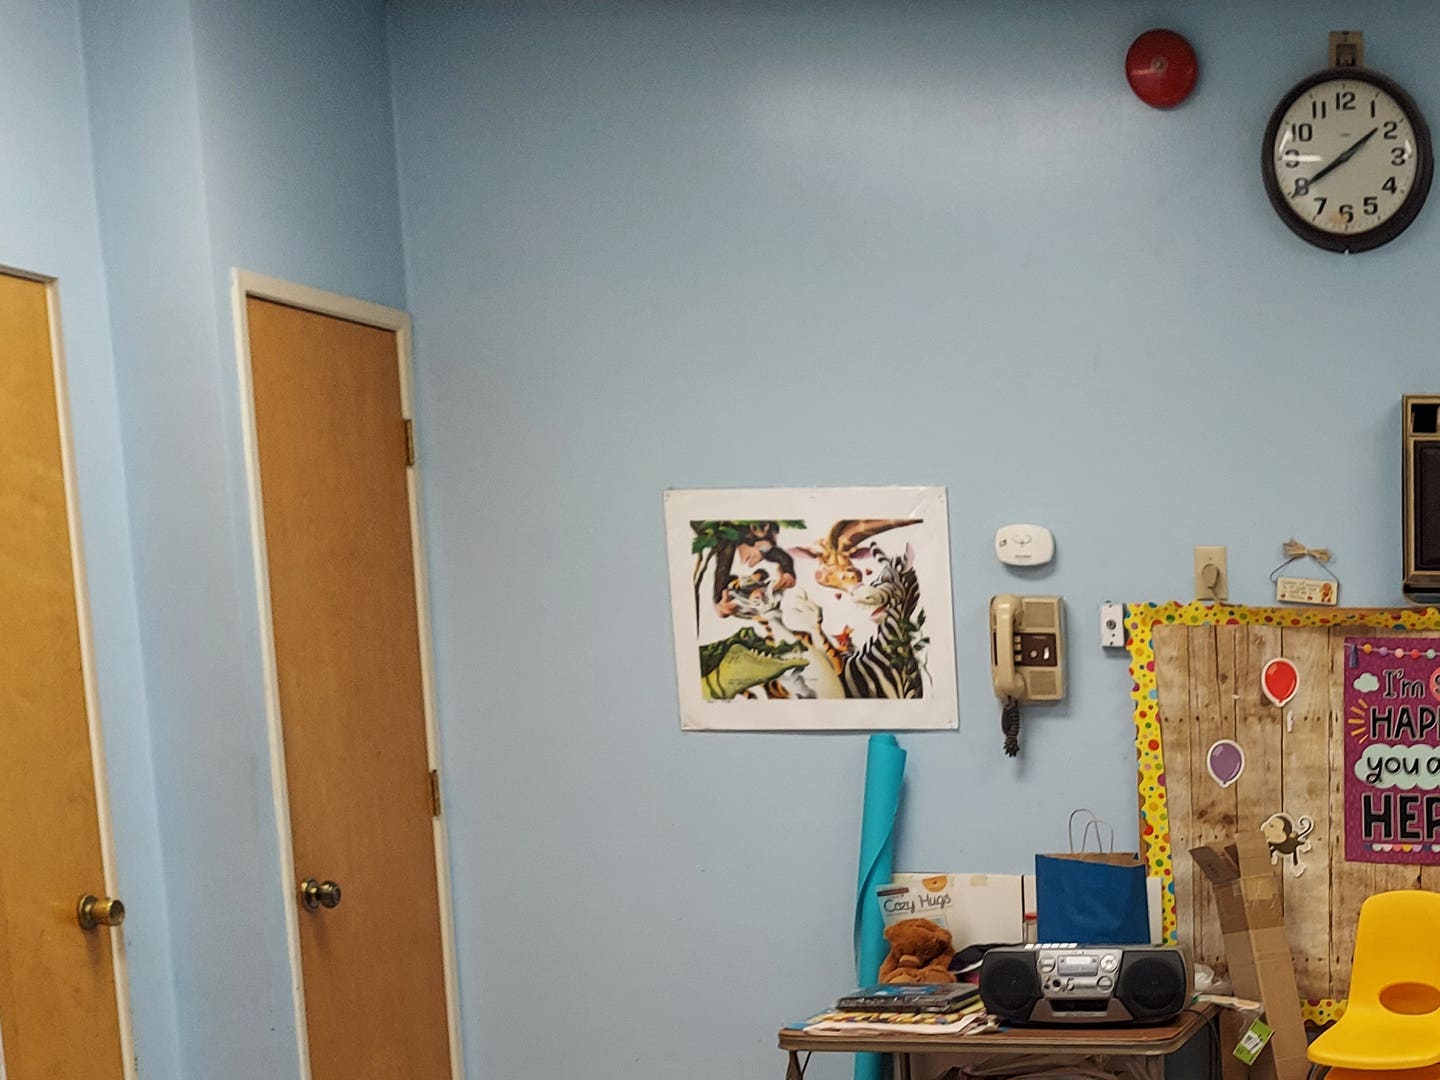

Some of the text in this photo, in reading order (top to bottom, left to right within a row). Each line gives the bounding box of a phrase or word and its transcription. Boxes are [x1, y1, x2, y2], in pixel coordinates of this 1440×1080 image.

[1312, 100, 1326, 119] 11
[1335, 91, 1356, 111] 12
[1291, 123, 1313, 142] 10
[1383, 121, 1398, 140] 2
[1390, 148, 1406, 166] 3
[1294, 177, 1310, 197] 8
[1381, 176, 1398, 195] 4
[1313, 197, 1328, 216] 7
[1339, 204, 1354, 224] 6
[1363, 196, 1378, 216] 5
[1382, 669, 1425, 699] I'm
[1366, 755, 1420, 785] you
[883, 893, 952, 914] Cozy Hugs
